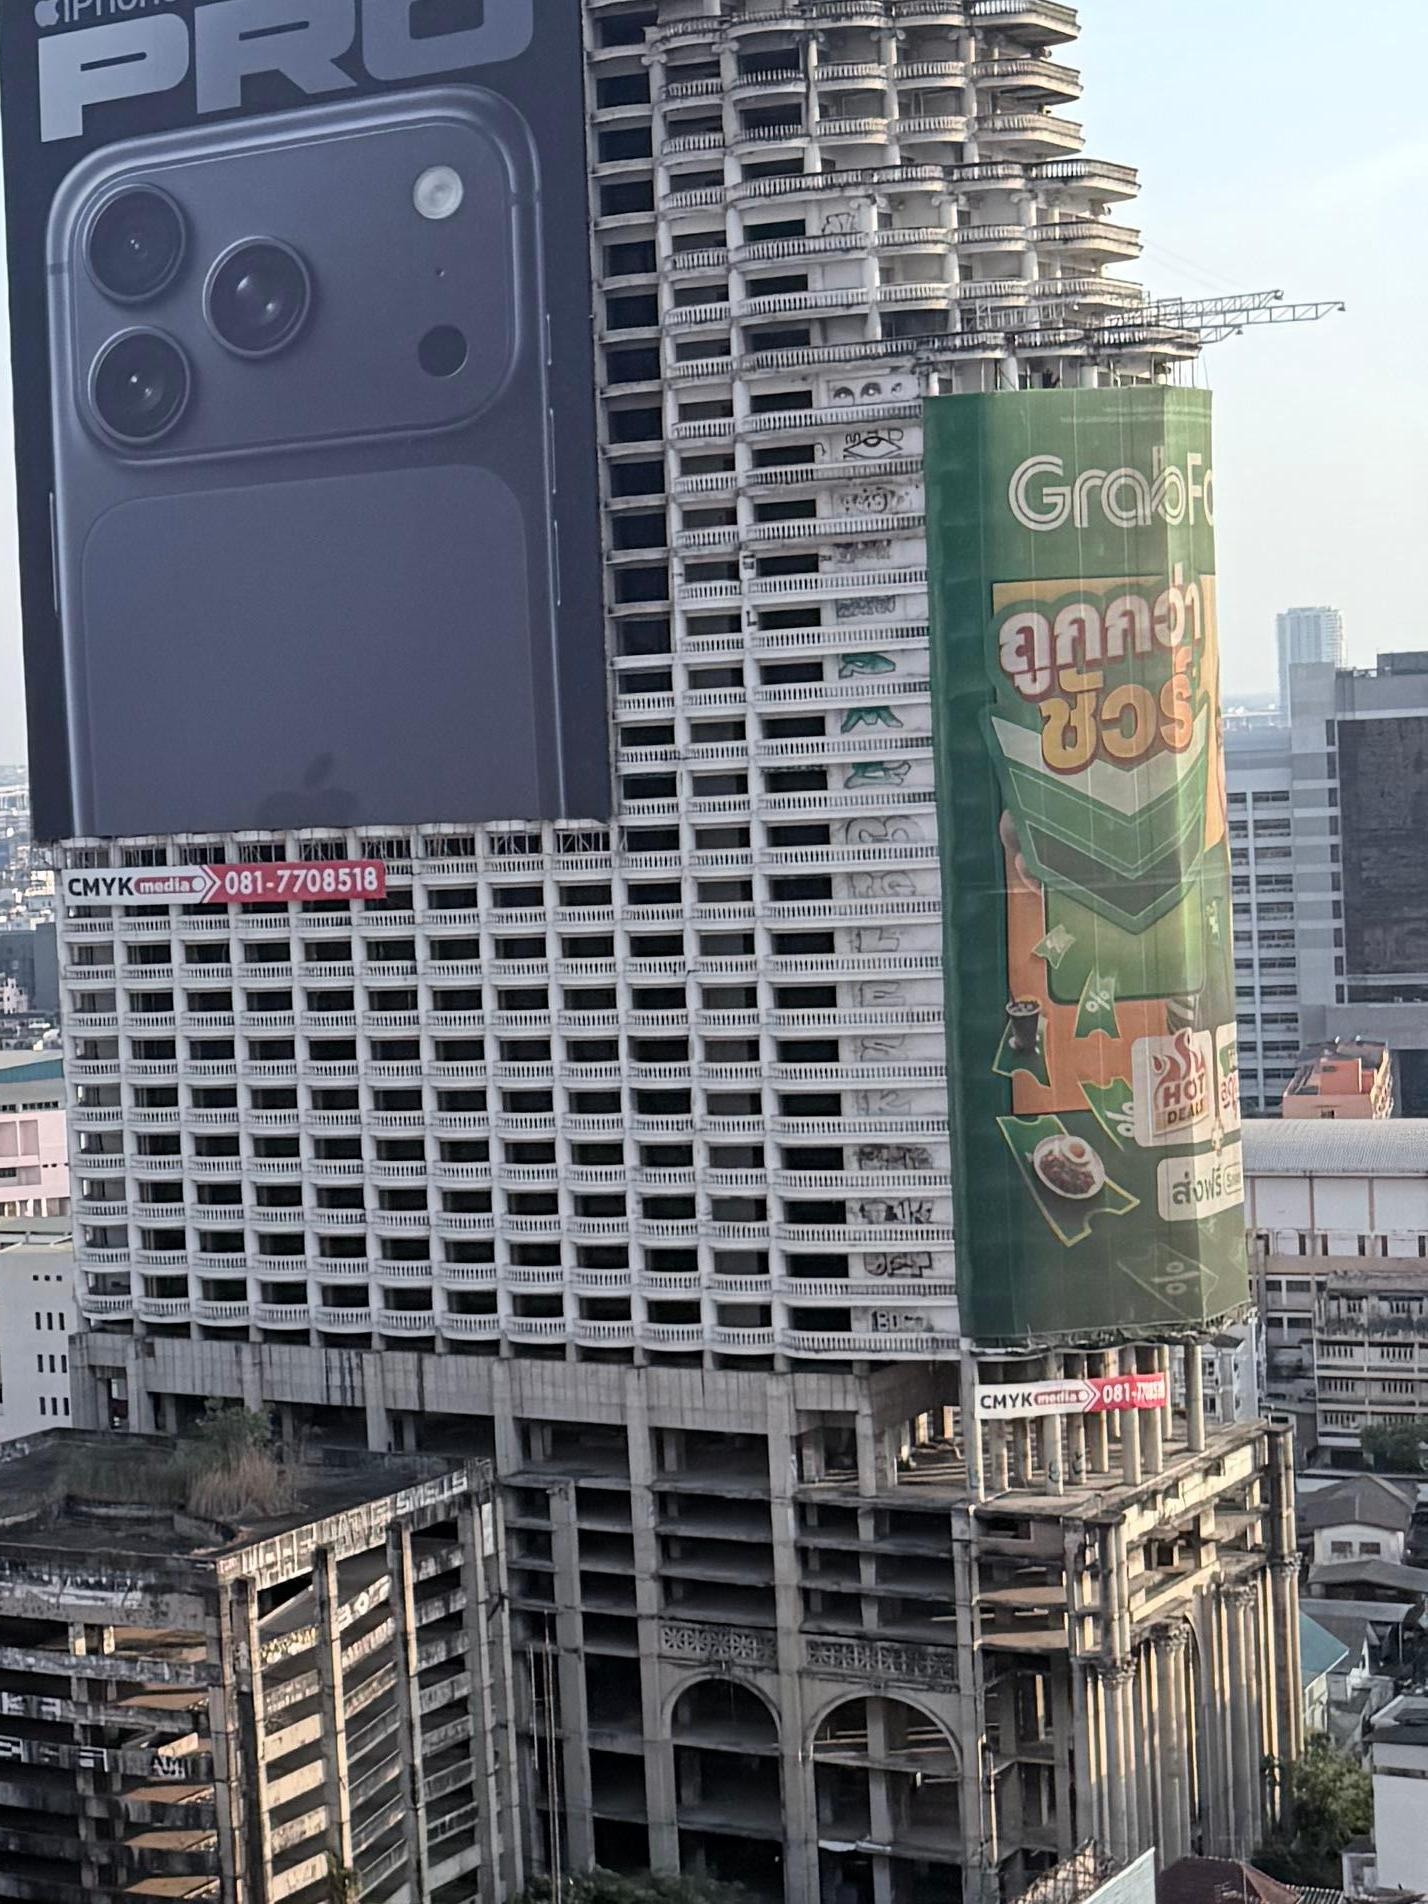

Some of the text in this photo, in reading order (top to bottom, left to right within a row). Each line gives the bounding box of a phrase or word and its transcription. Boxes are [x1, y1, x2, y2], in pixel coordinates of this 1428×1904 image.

[67, 865, 378, 898] CMYK media 081-7708518
[1163, 1072, 1206, 1109] HOT
[1171, 1166, 1223, 1206] ส่งฟรี
[980, 1392, 1033, 1410] CMYK
